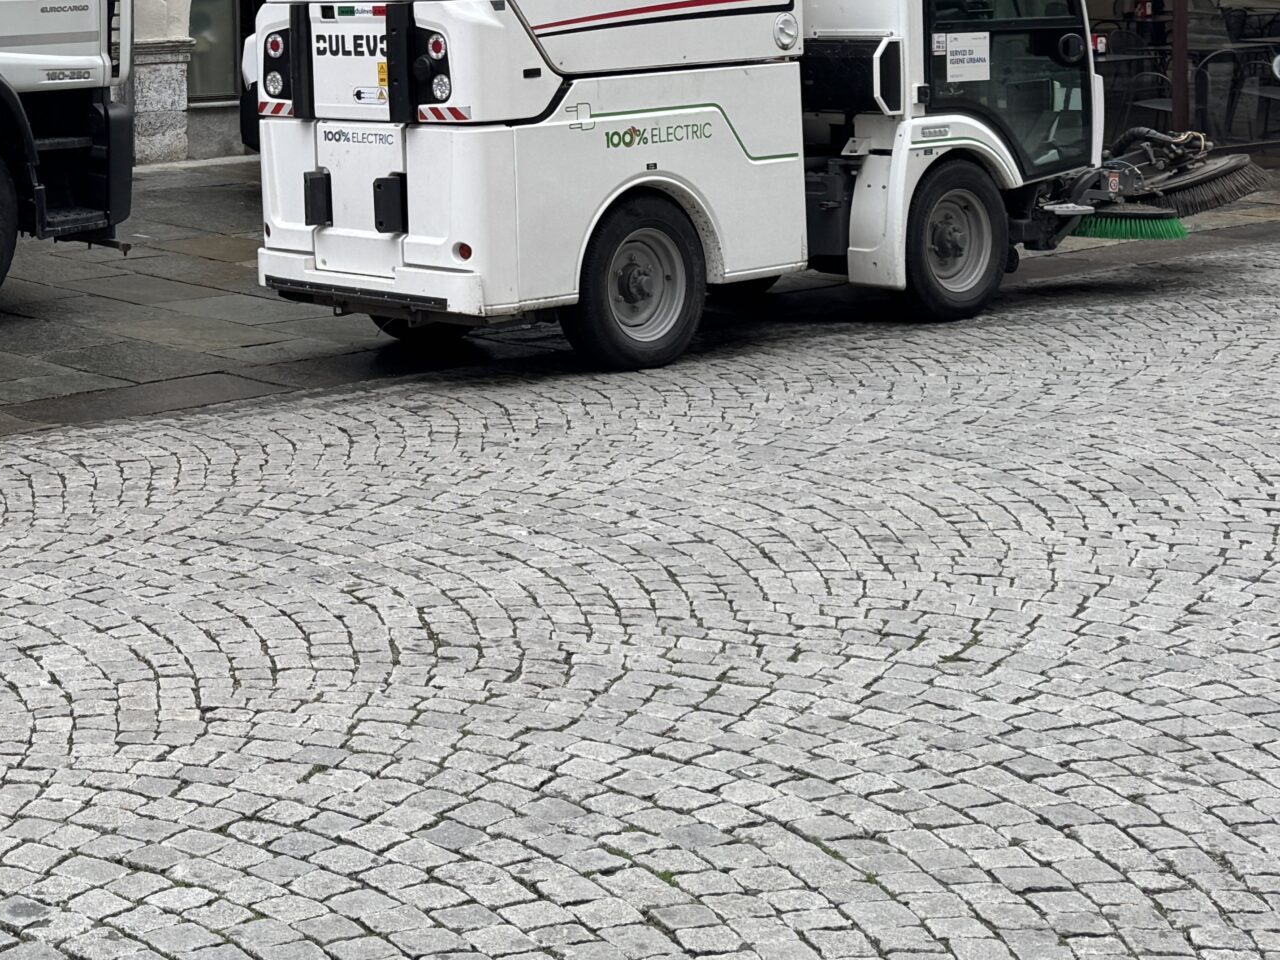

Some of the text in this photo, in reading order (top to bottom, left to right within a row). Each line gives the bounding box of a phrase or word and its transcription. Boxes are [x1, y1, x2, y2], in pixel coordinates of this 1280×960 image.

[40, 5, 89, 13] EUROCARGO
[323, 129, 394, 145] 100% ELECTRIC
[604, 122, 713, 149] 100% ELECTRIC
